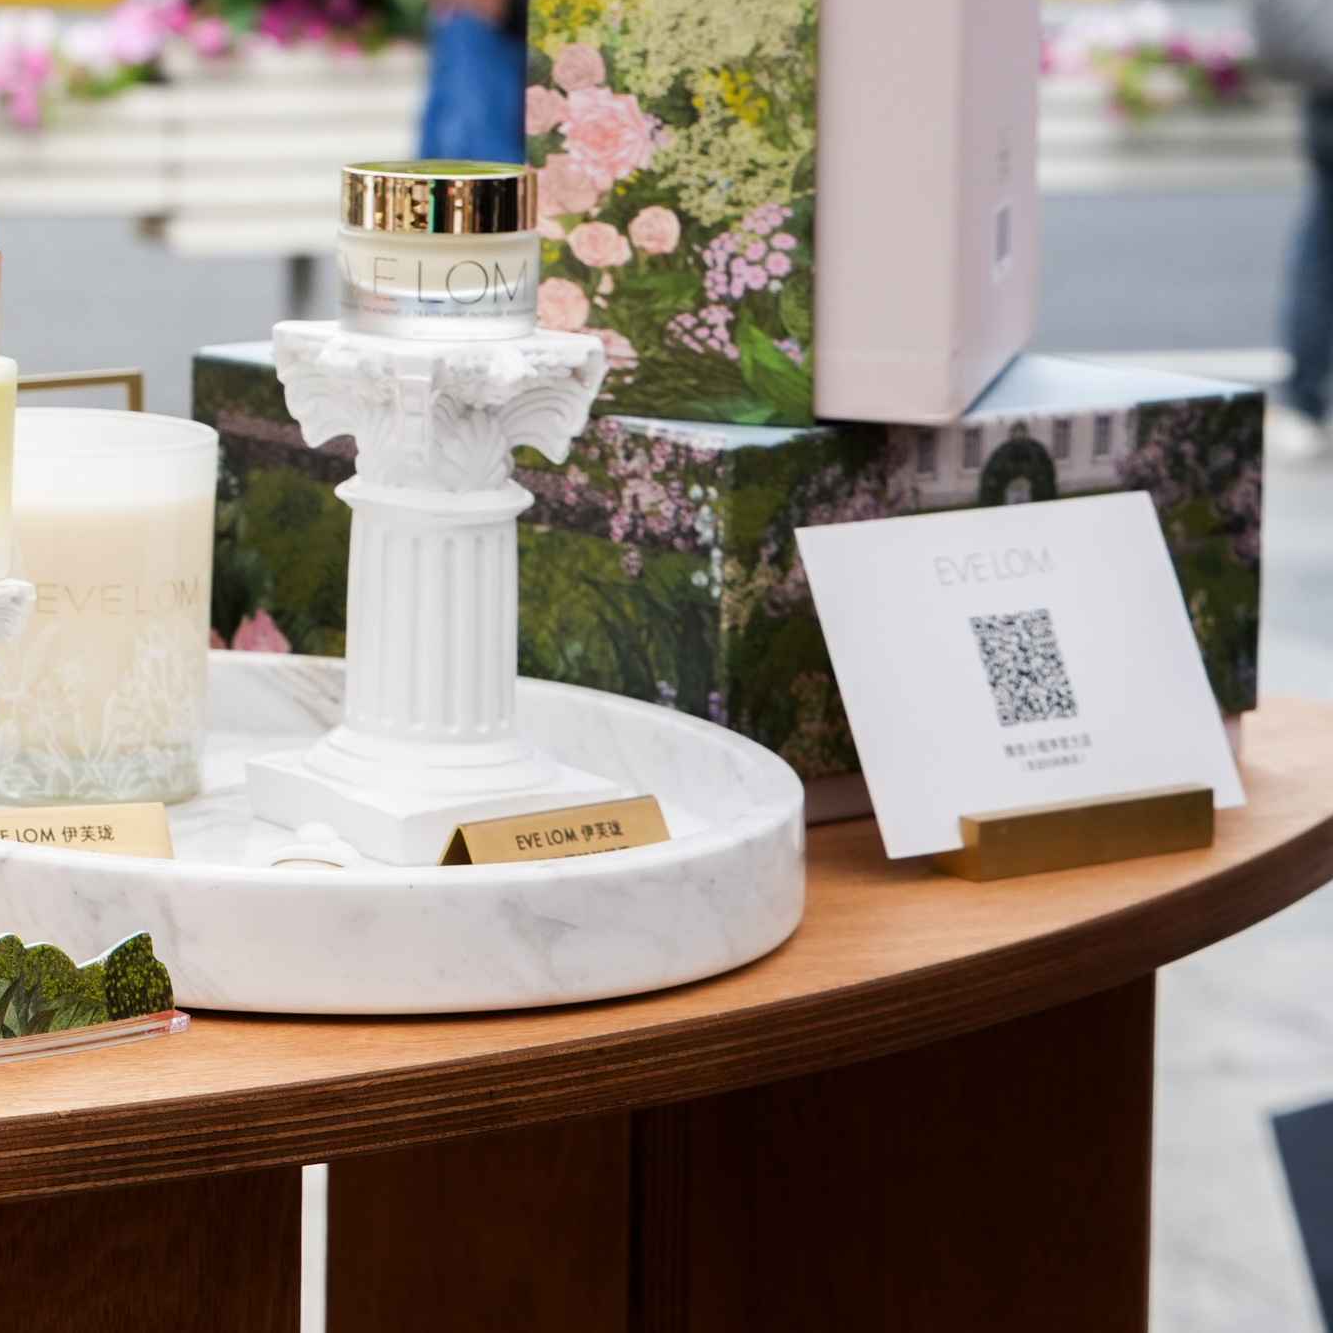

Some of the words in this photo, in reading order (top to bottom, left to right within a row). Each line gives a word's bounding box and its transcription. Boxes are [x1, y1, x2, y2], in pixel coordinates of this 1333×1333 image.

[418, 258, 528, 305] LOM
[933, 552, 990, 586] EVE
[989, 547, 1054, 581] LOM
[35, 583, 123, 615] EVE
[134, 576, 200, 615] LOM
[15, 827, 56, 843] LOM
[61, 824, 116, 843] 伊芙珑
[515, 833, 543, 850] EVE
[544, 828, 579, 846] LOM
